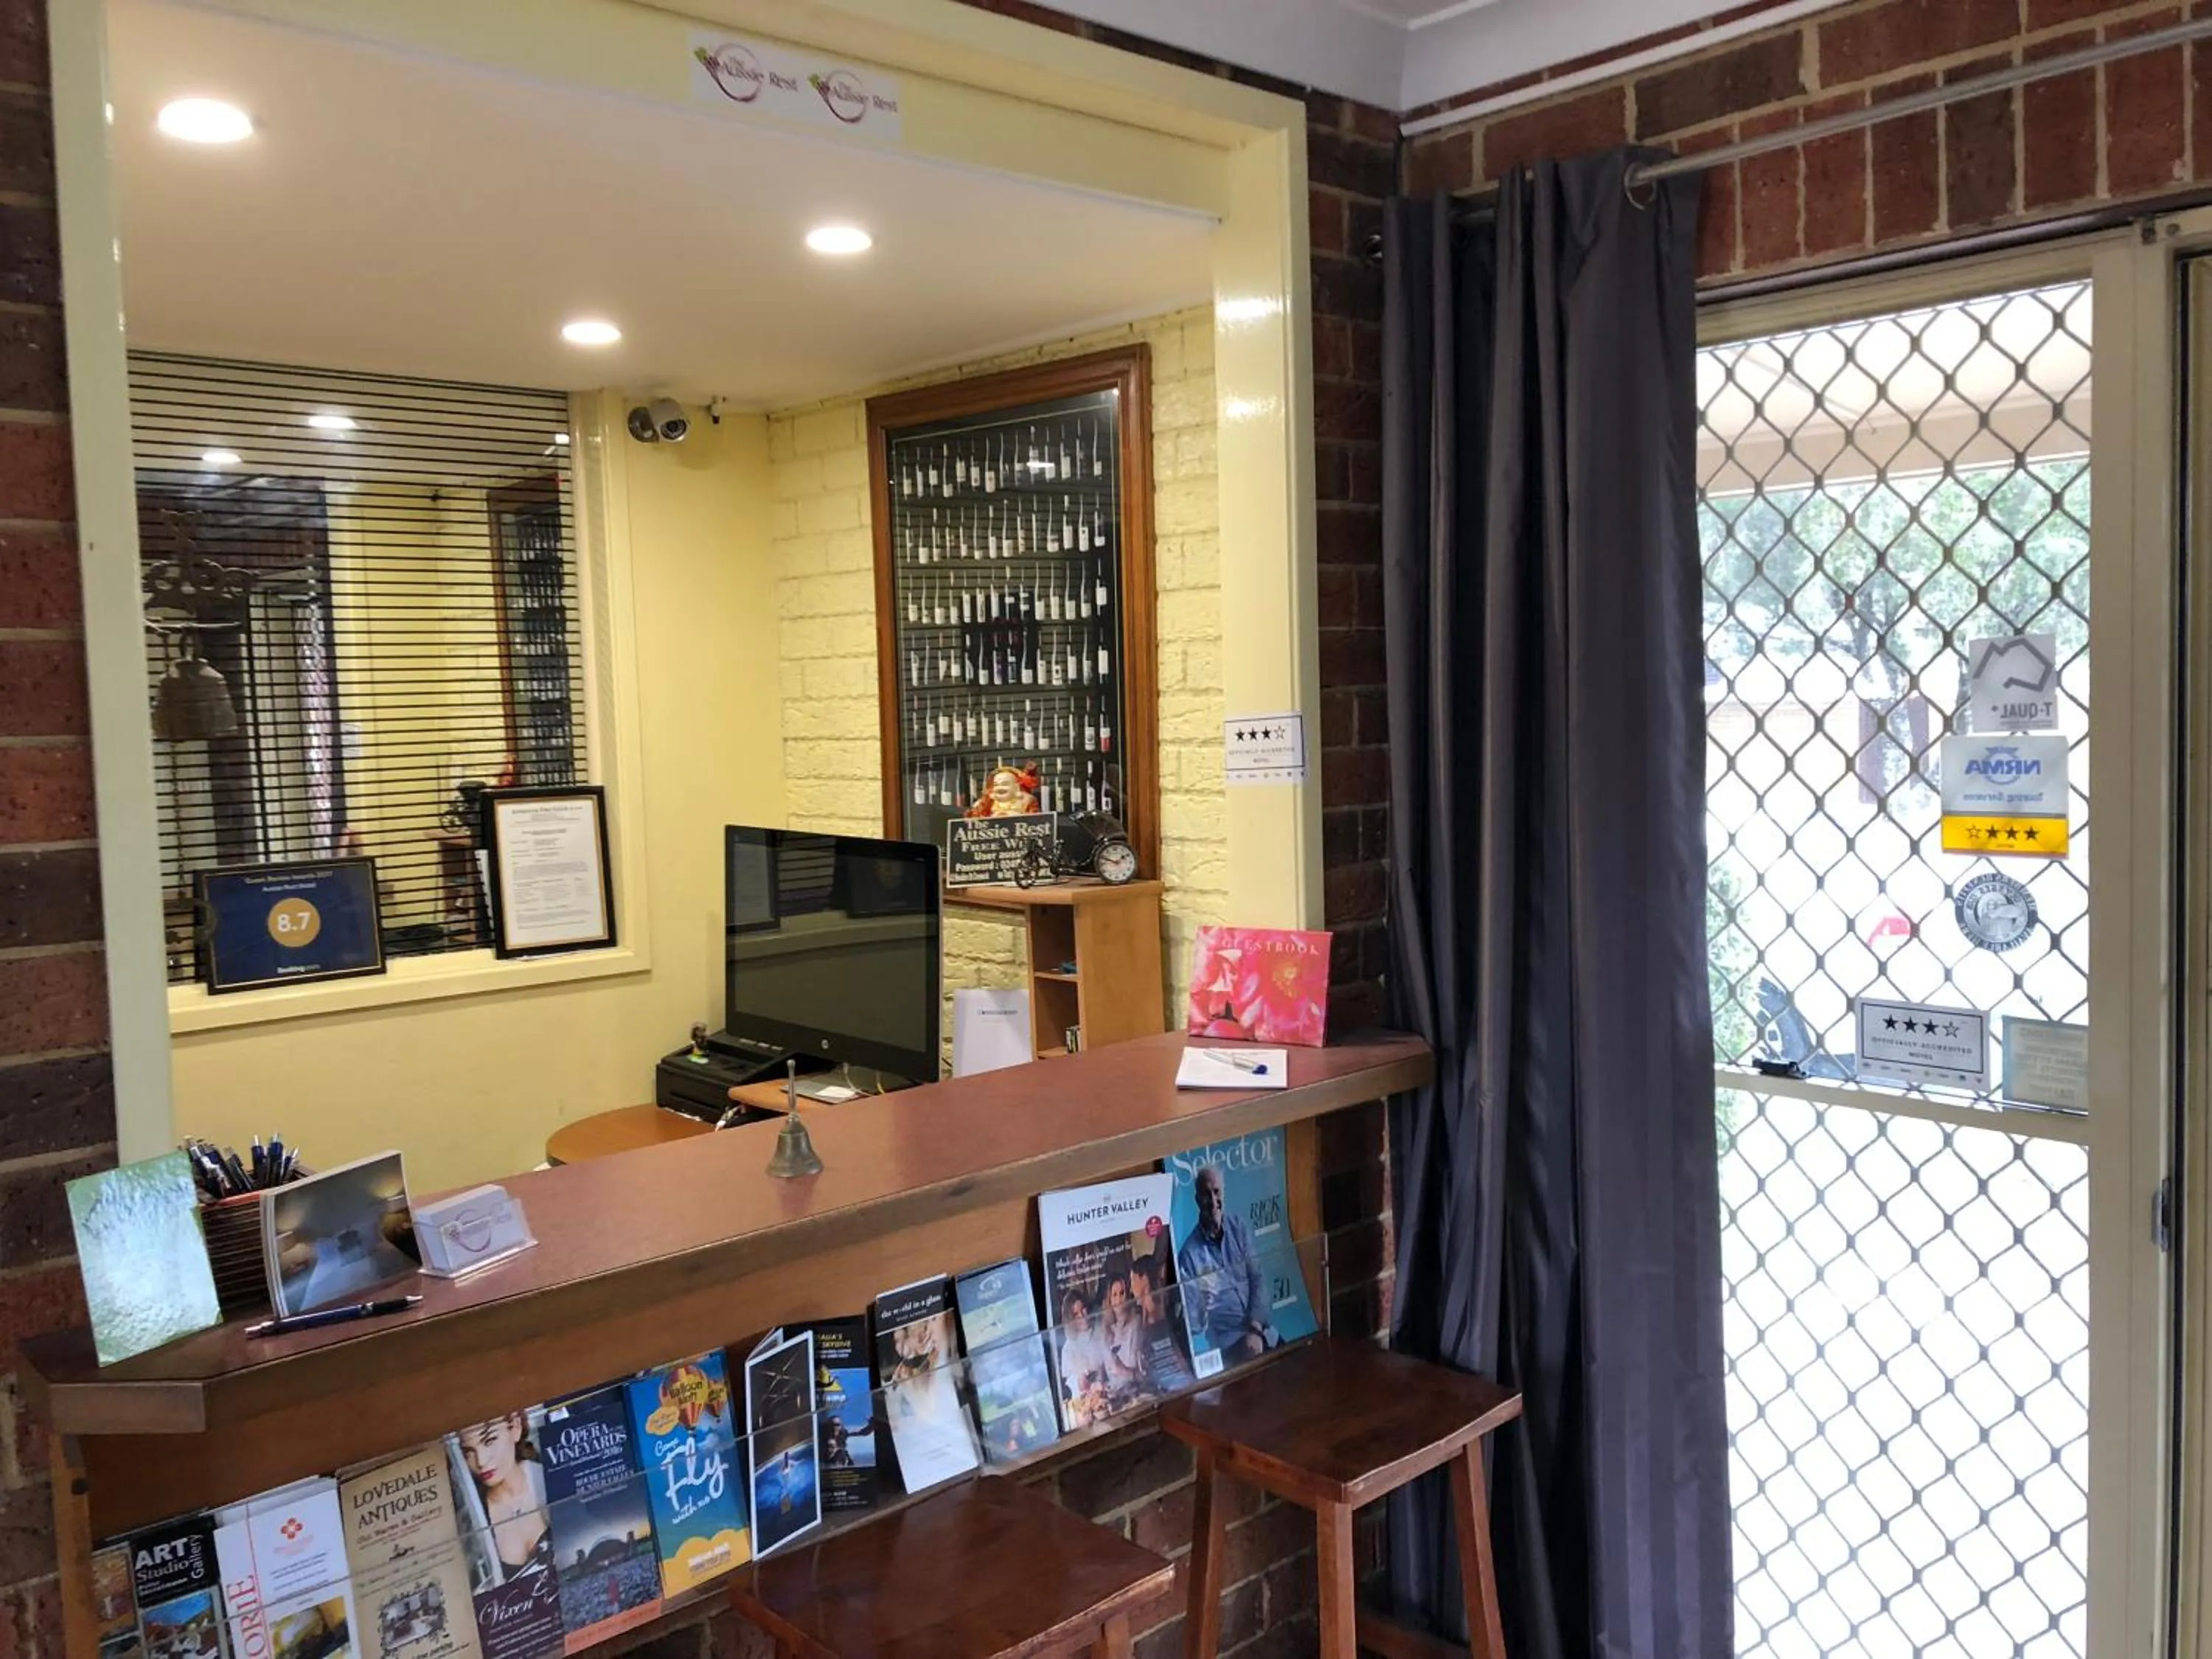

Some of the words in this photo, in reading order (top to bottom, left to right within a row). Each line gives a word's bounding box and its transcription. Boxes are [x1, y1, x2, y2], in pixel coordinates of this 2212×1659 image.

[953, 824, 1009, 842] Aussie
[1014, 821, 1051, 837] Rest
[277, 912, 311, 933] 8.7
[1172, 1134, 1279, 1189] Selector
[1067, 1206, 1109, 1225] HUNTER
[1110, 1197, 1150, 1214] VALLEY
[546, 1433, 627, 1465] VINEYARDS
[353, 1464, 438, 1509] LOVEDALE
[661, 1437, 729, 1512] Fly
[358, 1484, 439, 1529] ANTIQUES
[135, 1537, 189, 1571] ART
[136, 1559, 189, 1582] Studio
[225, 1574, 267, 1659] ORIE
